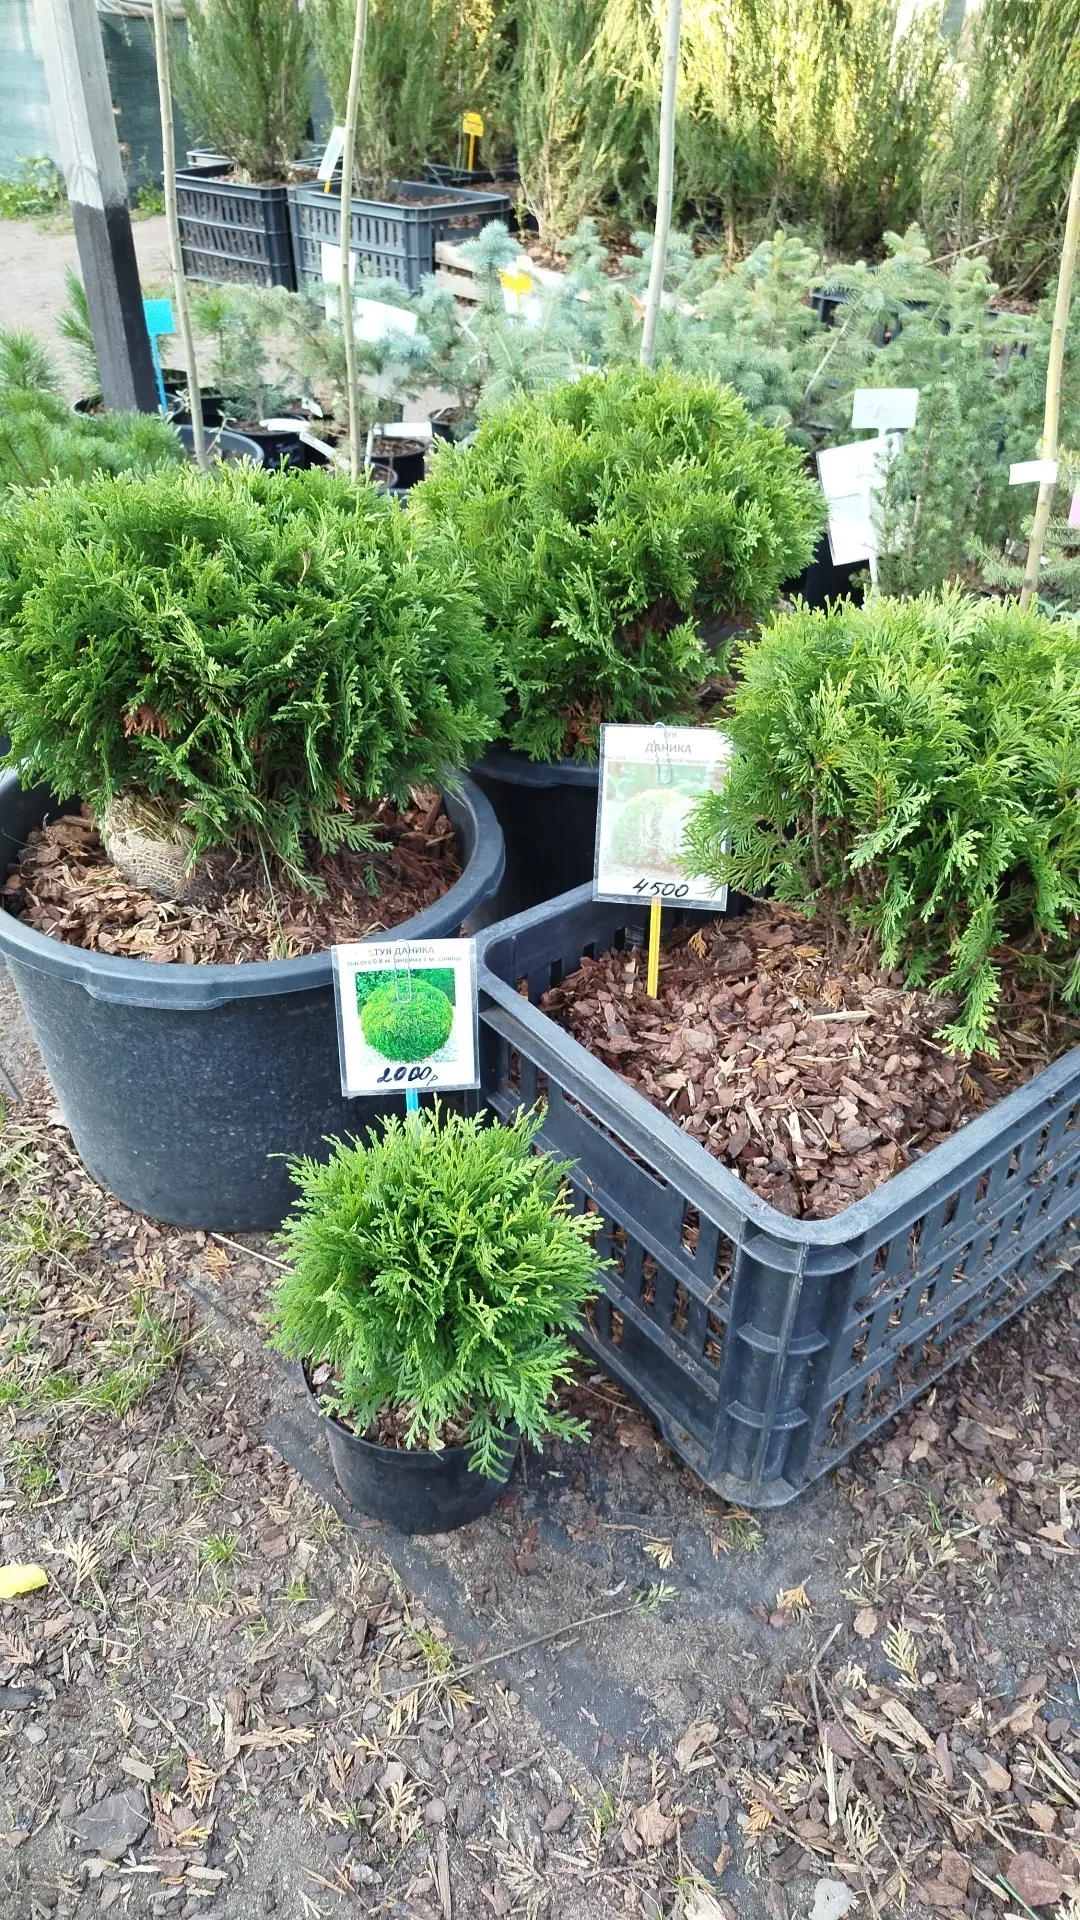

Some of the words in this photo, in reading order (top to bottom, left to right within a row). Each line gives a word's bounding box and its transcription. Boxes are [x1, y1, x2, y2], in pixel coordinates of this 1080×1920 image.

[645, 743, 692, 754] ДАНИКА
[632, 878, 690, 898] 4500
[374, 948, 392, 956] ТУЯ
[394, 946, 435, 956] ДАНИКА
